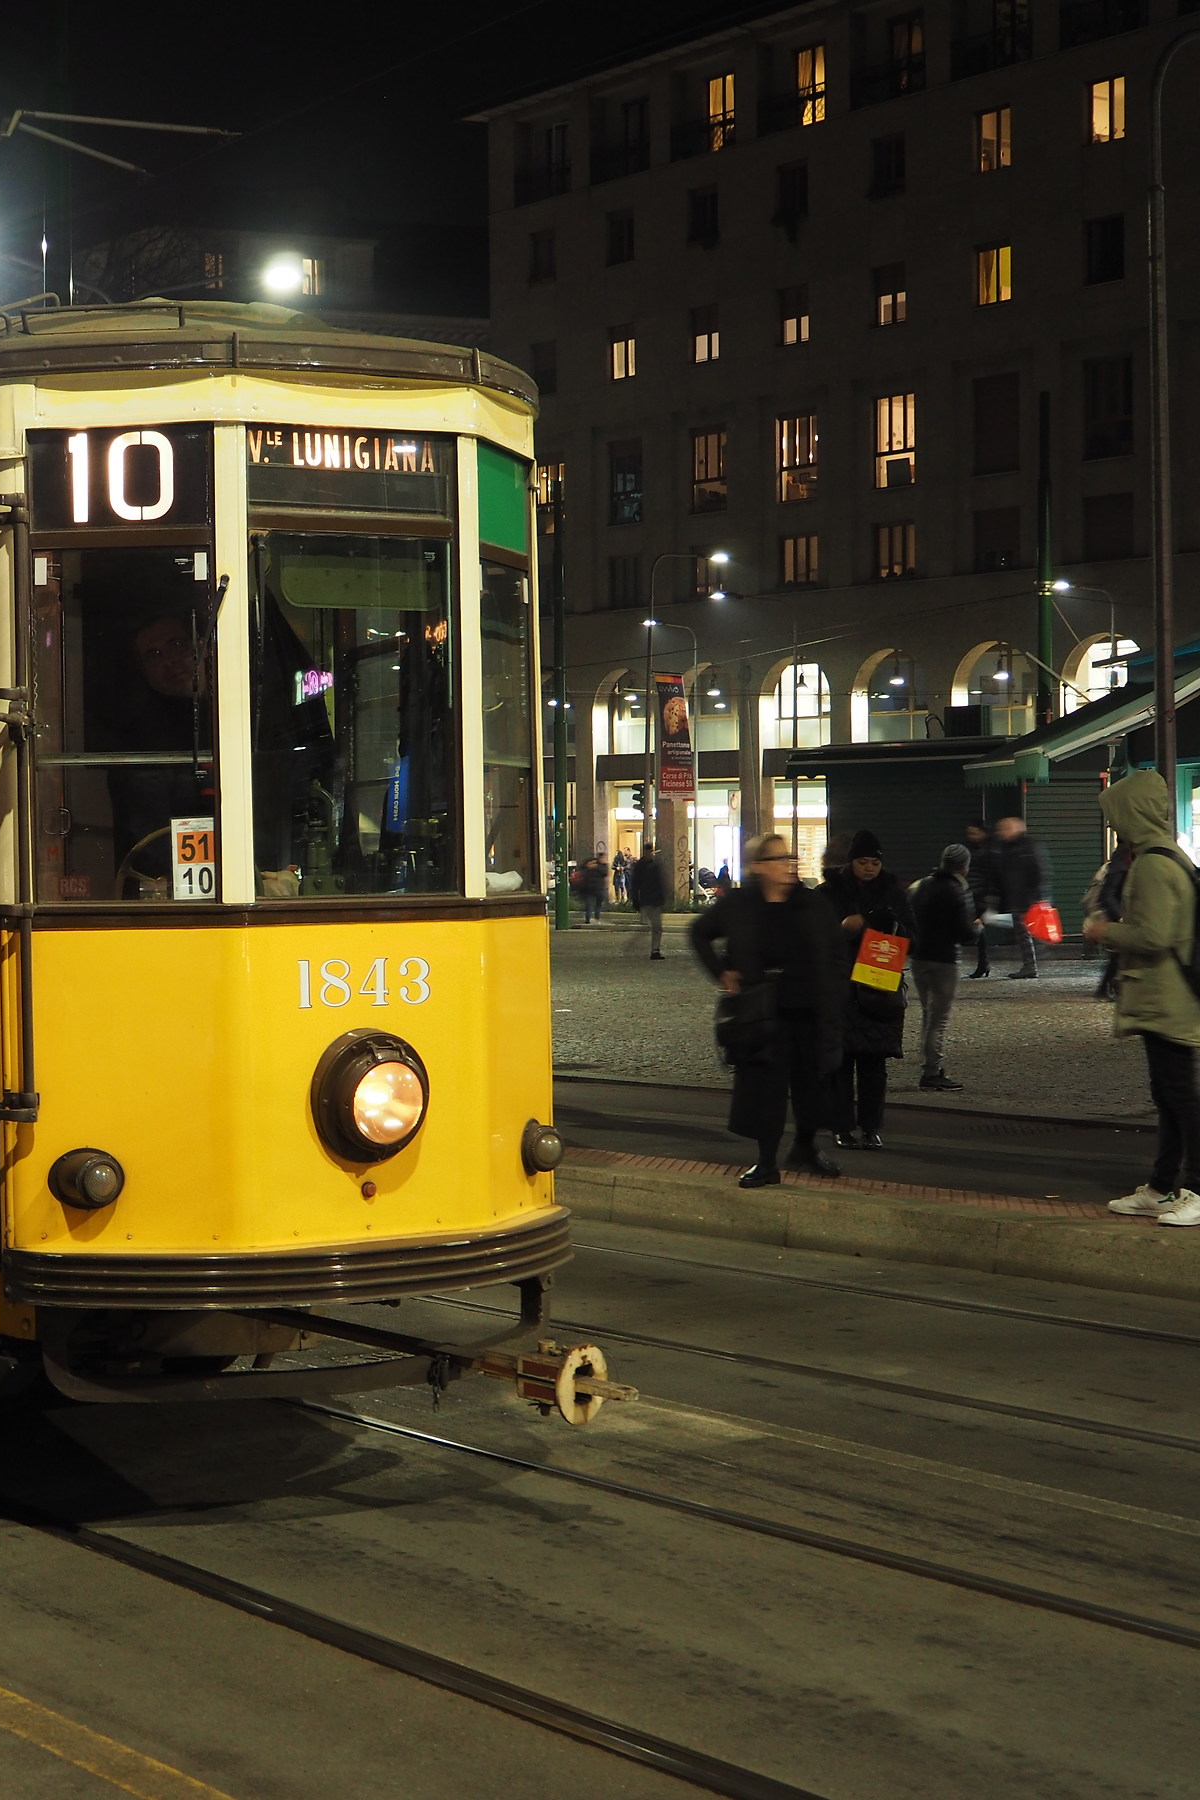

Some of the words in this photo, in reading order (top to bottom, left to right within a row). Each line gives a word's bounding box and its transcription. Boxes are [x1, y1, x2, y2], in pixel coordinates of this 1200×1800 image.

[292, 432, 435, 473] LUNIGIANA
[67, 431, 174, 523] 10
[181, 833, 209, 862] 51
[183, 867, 213, 895] 10
[297, 956, 431, 1009] 1843
